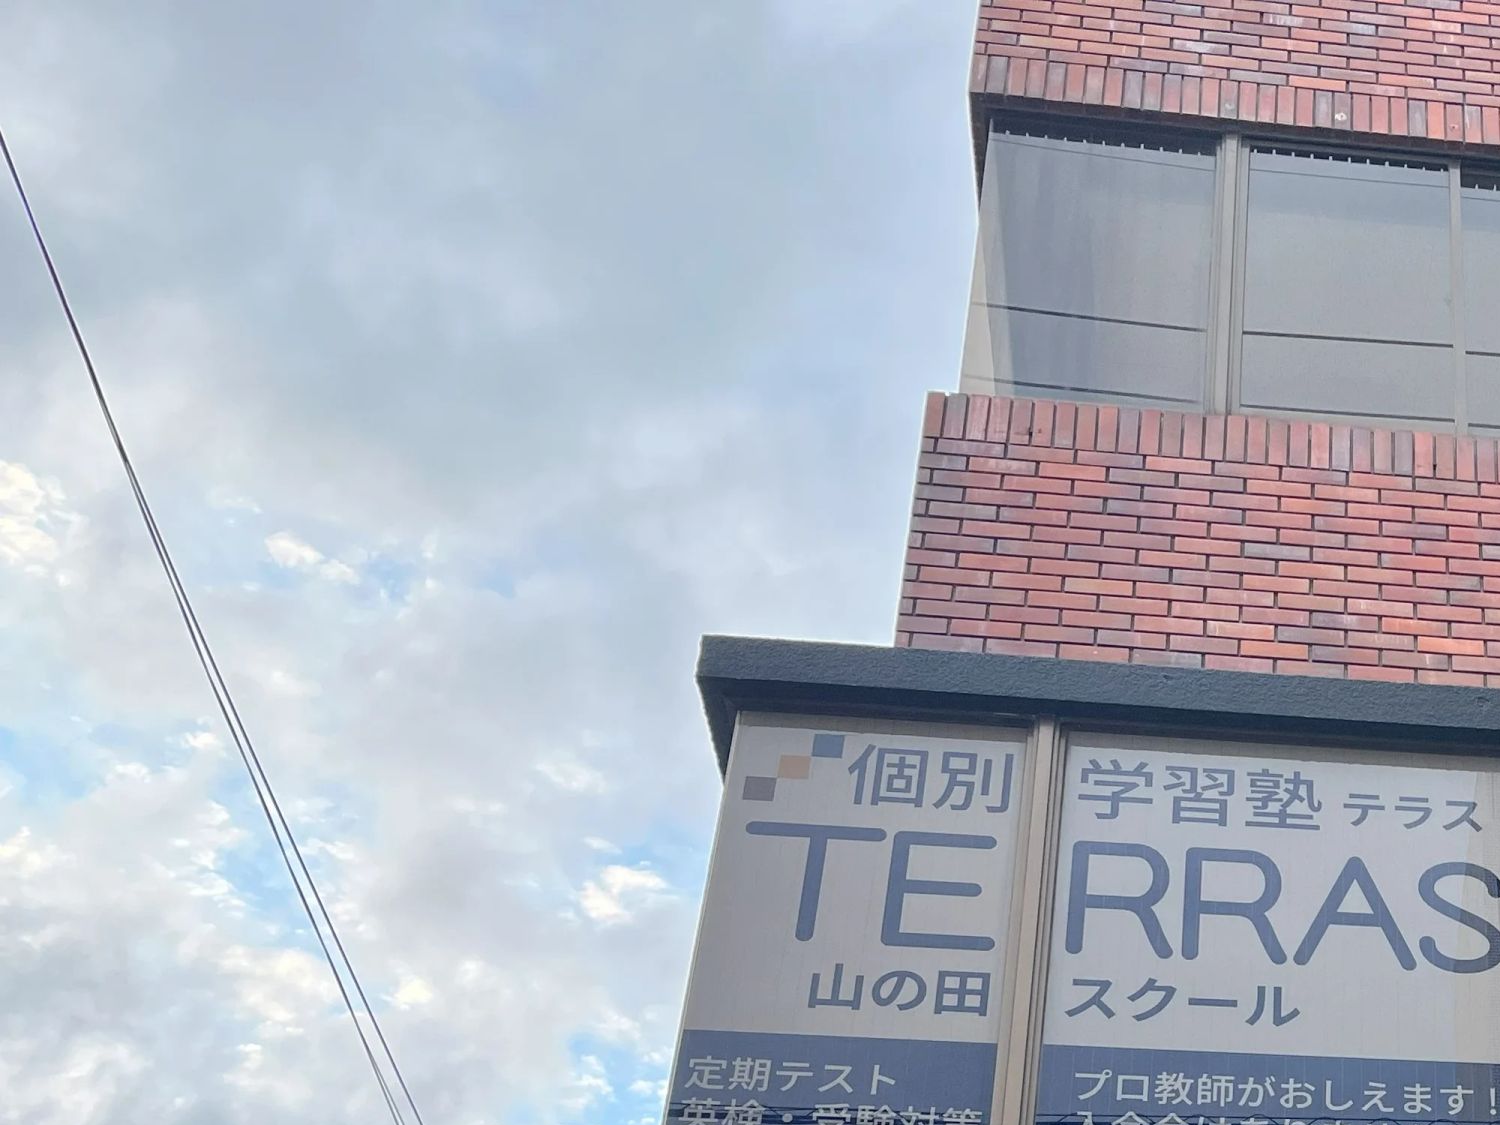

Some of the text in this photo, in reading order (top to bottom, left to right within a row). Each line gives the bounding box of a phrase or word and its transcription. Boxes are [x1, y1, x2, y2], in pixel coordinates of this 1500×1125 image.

[1343, 793, 1483, 832] テラス
[684, 1055, 896, 1096] 定期テスト
[1074, 1069, 1499, 1116] プロ教師がおしえます!
